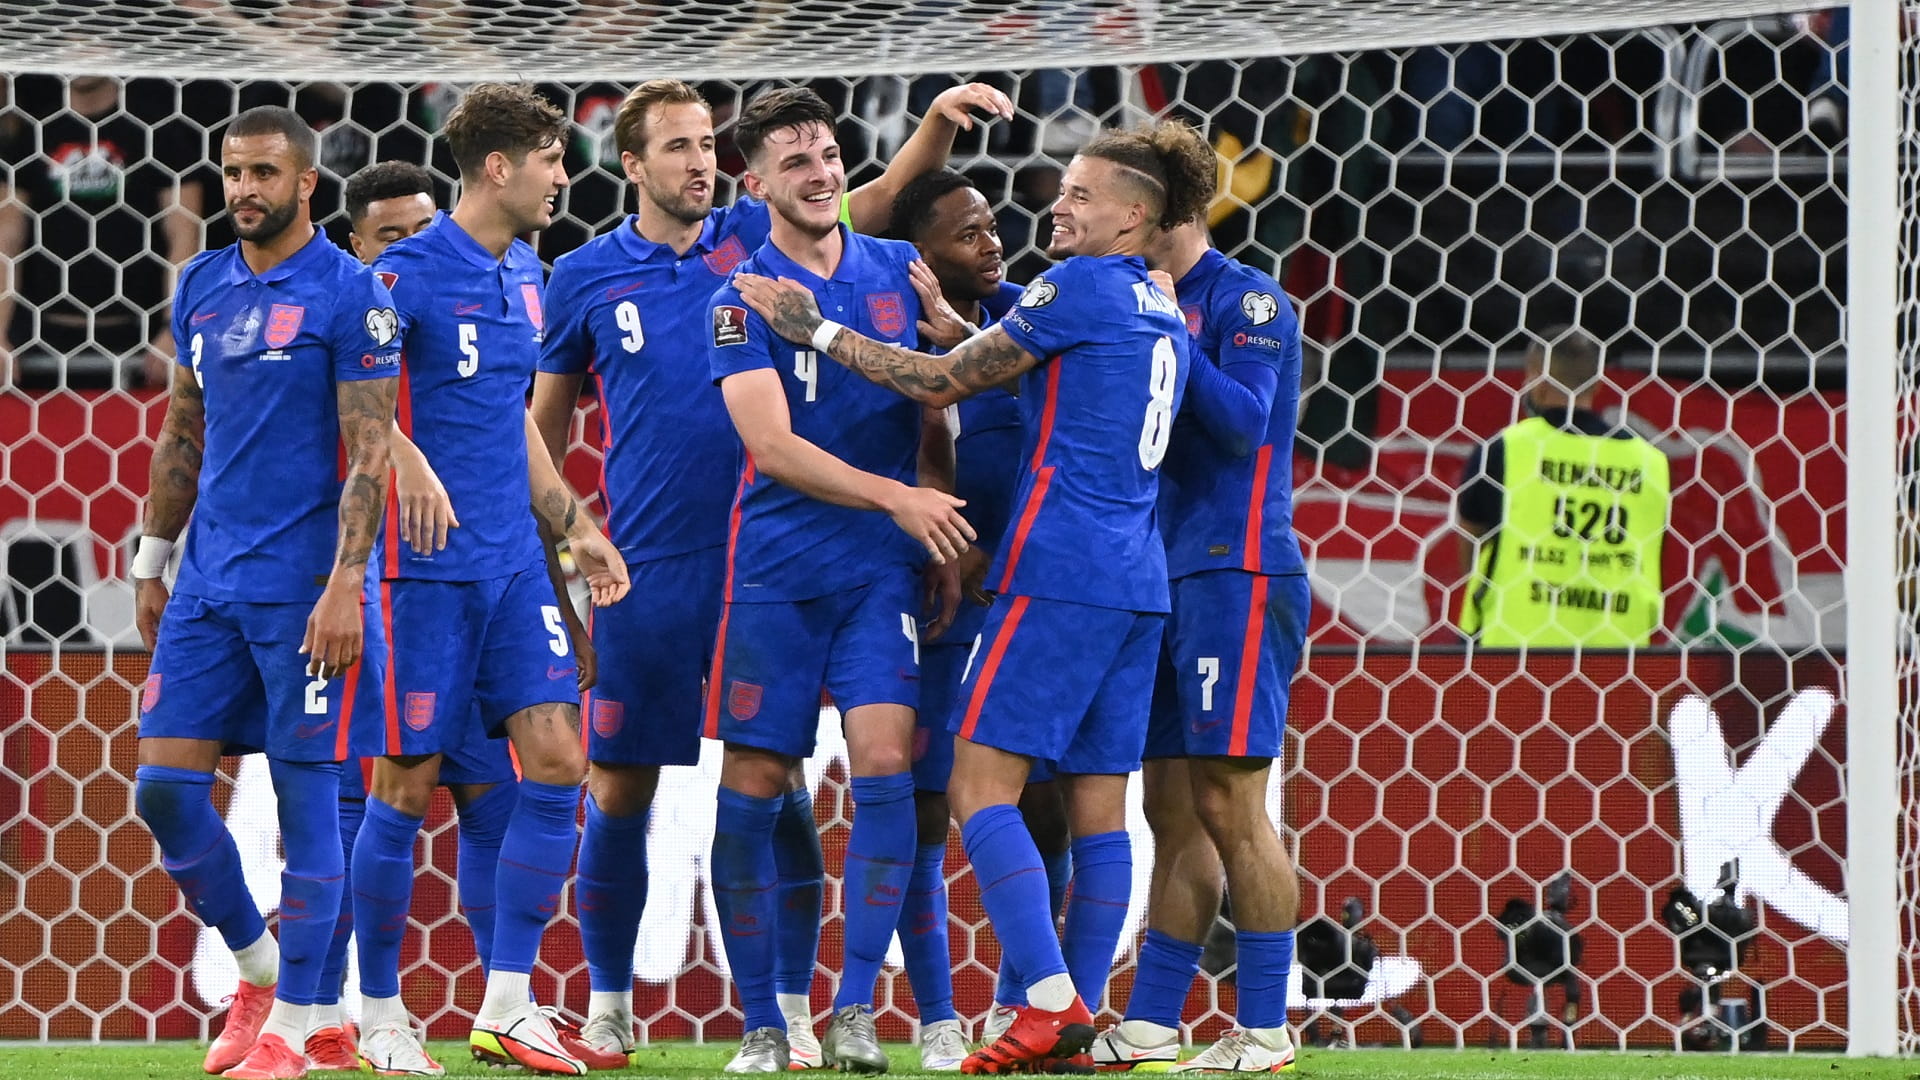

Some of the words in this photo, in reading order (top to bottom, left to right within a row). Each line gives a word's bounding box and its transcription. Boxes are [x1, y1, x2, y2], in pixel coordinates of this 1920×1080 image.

[457, 323, 479, 378] 5
[614, 301, 645, 353] 9
[1247, 336, 1281, 349] RESPECT
[794, 351, 817, 401] 4
[1138, 335, 1177, 471] 8
[1553, 495, 1627, 545] 520
[540, 605, 569, 658] 5
[900, 612, 919, 665] 4
[304, 661, 328, 714] 2
[1197, 657, 1219, 711] 7
